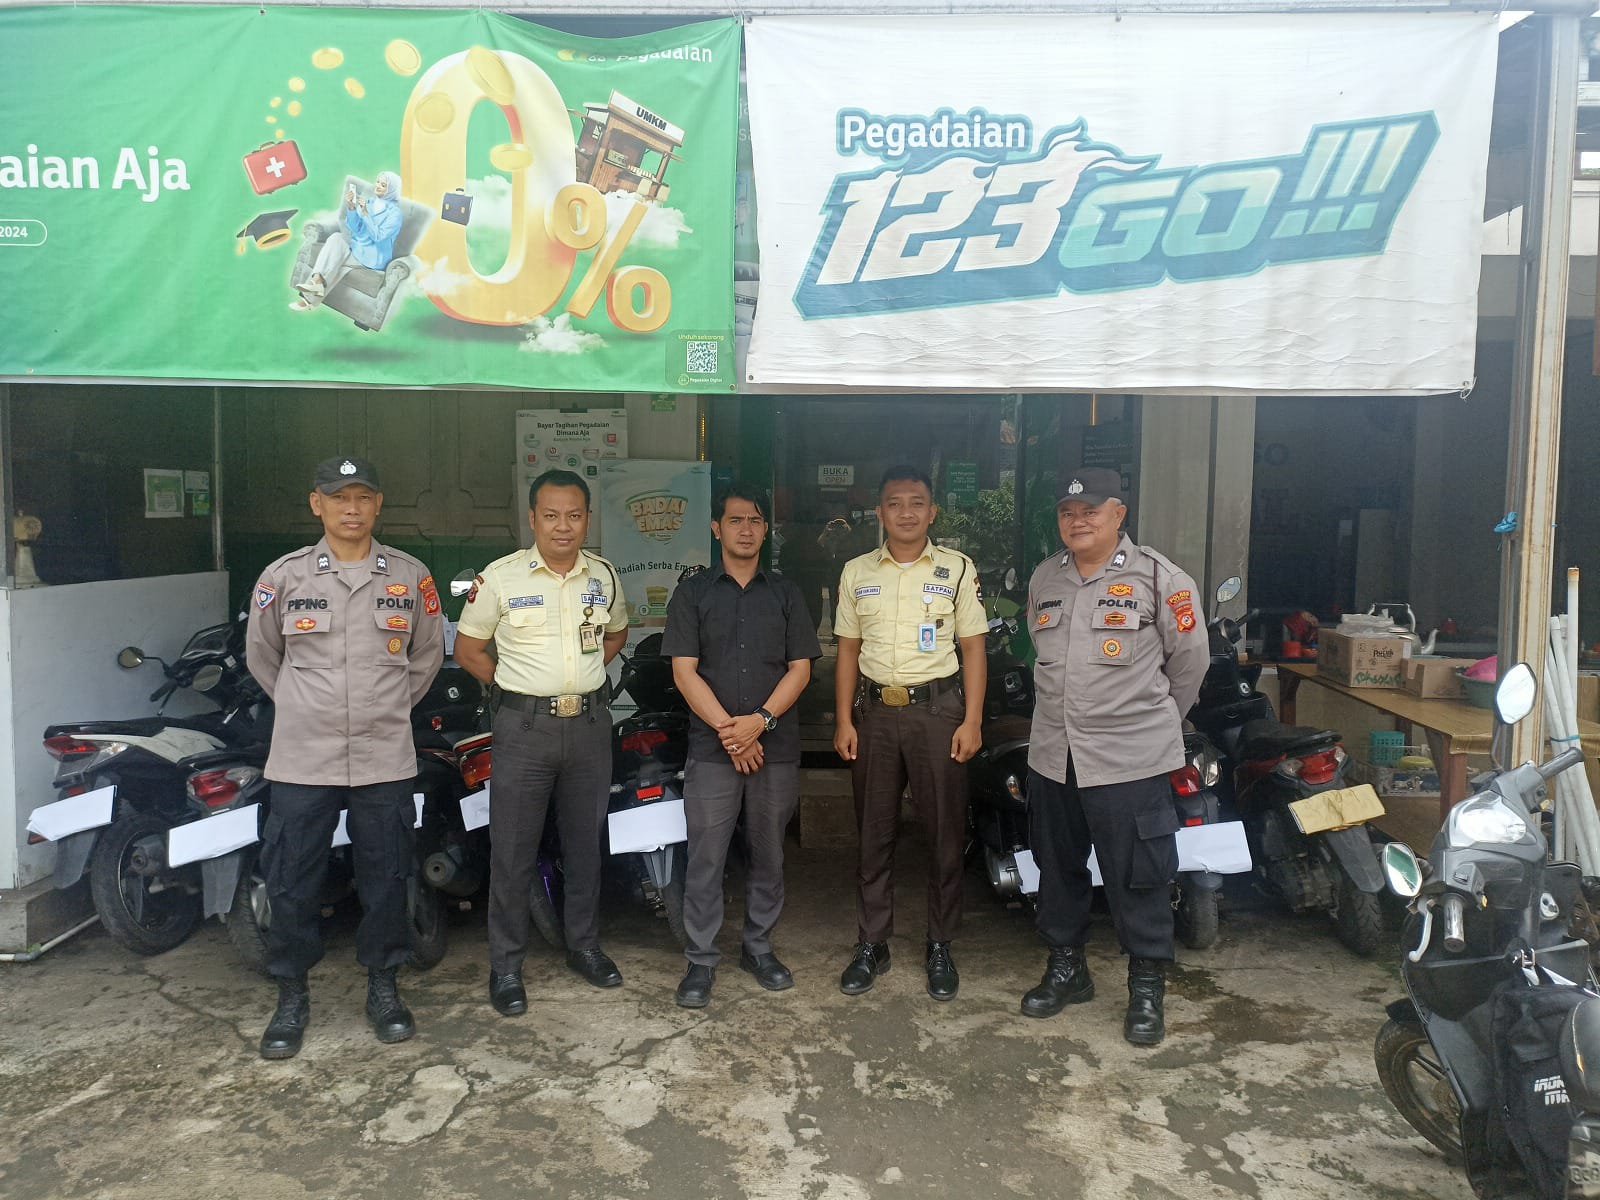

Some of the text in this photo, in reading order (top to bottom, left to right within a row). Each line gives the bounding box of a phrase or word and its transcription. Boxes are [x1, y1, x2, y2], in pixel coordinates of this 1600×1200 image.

[636, 106, 667, 131] UMKM
[843, 113, 1027, 157] Pegadaian
[111, 146, 191, 202] Aja
[814, 150, 1085, 286] 123
[579, 421, 610, 429] Pegadaian
[823, 466, 849, 476] BUKA
[629, 497, 687, 516] BADAI
[637, 515, 684, 532] EMAS
[615, 562, 646, 575] Hadiah
[647, 561, 673, 570] Serba
[925, 585, 952, 595] SATPAM
[287, 598, 328, 610] PIPING
[377, 598, 414, 610] POLRI
[583, 595, 606, 604] SAPAM
[1097, 599, 1138, 609] POLRI
